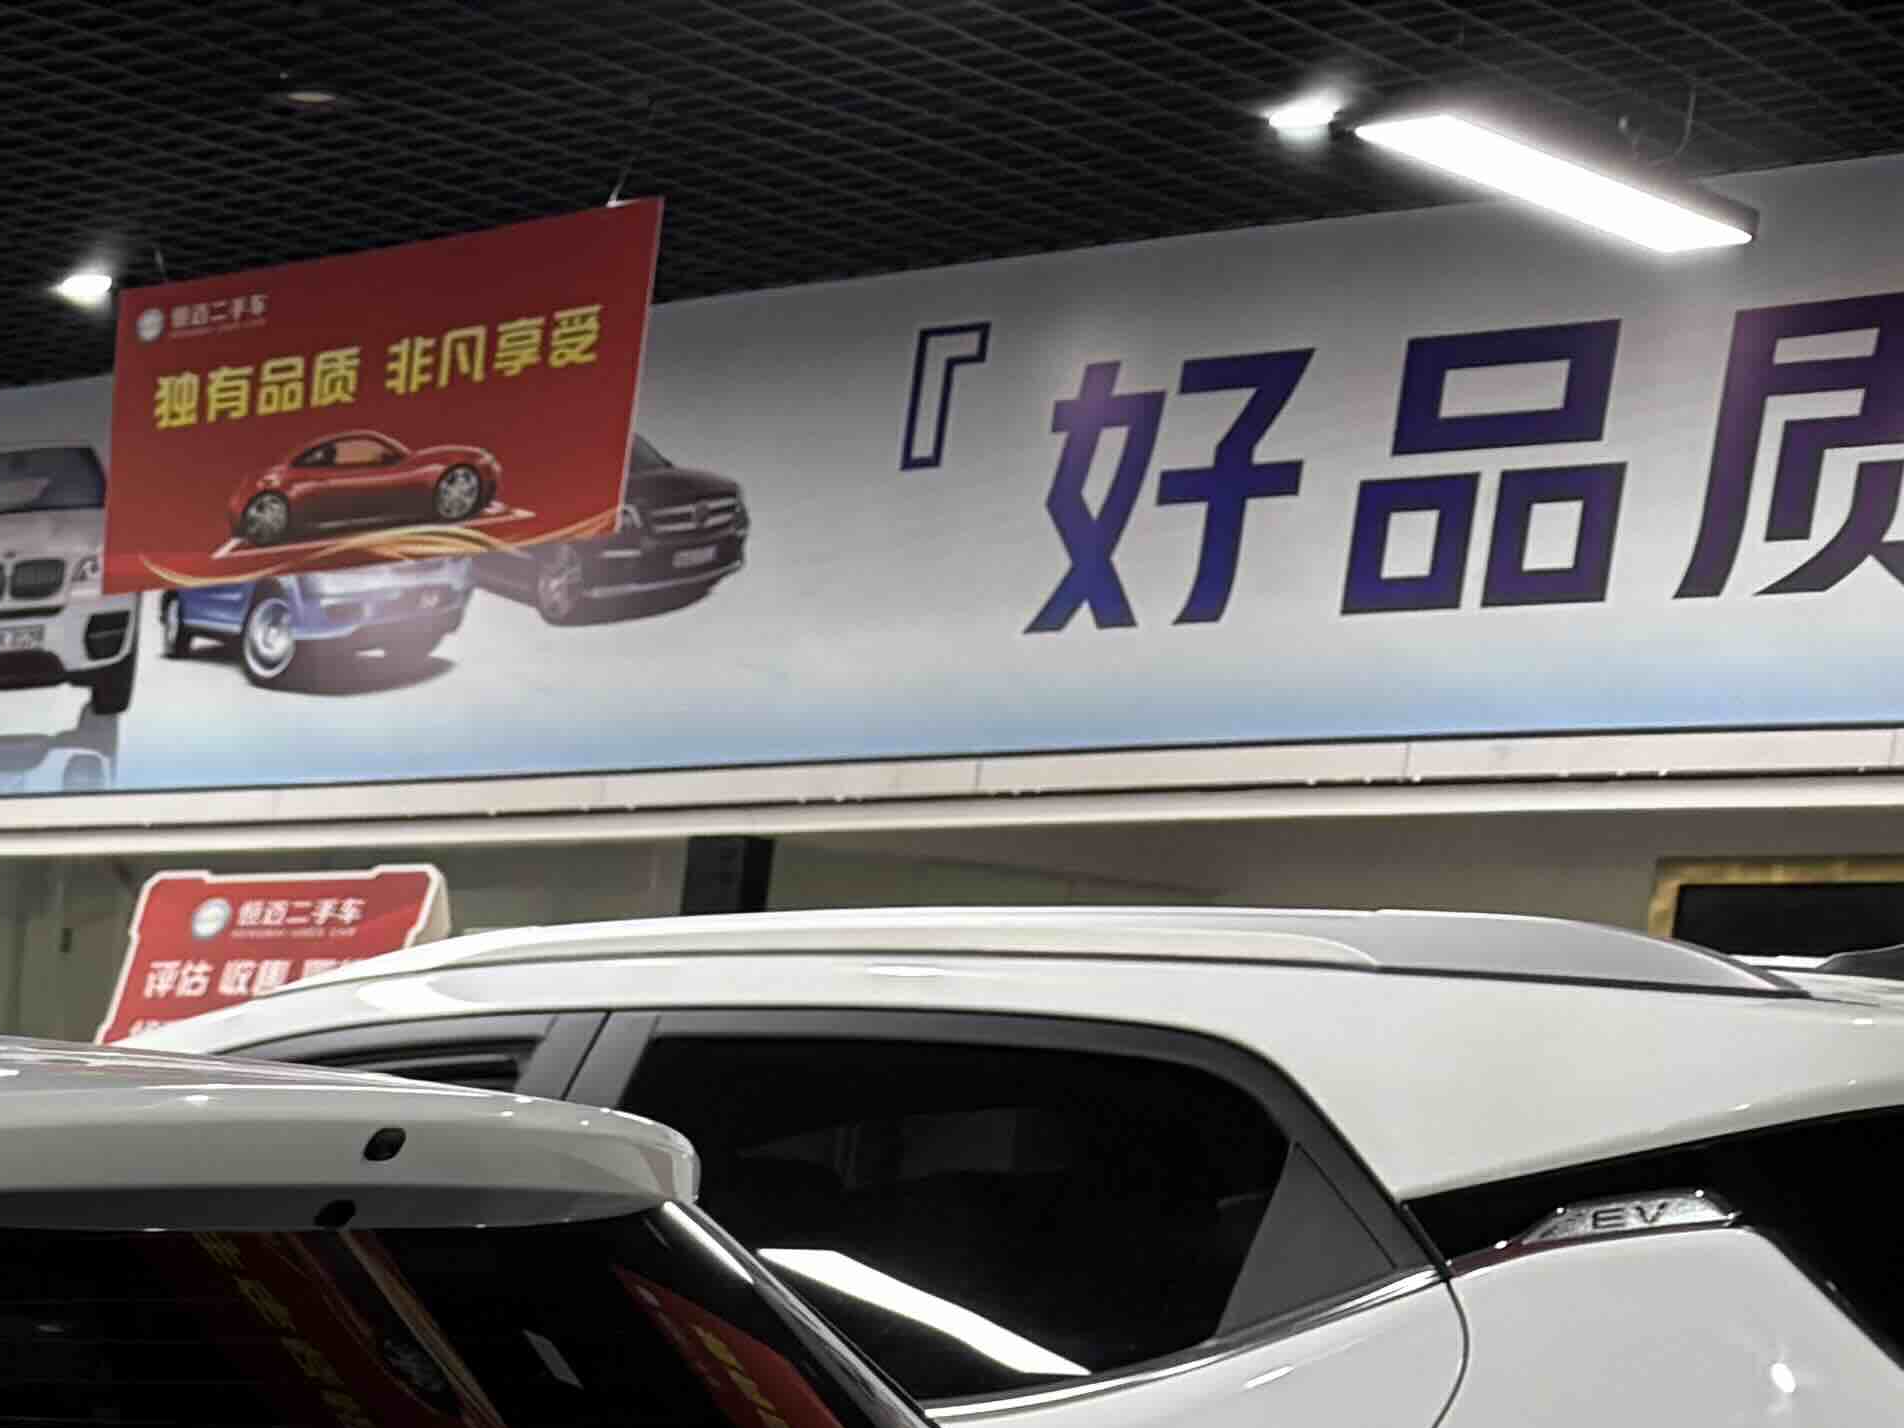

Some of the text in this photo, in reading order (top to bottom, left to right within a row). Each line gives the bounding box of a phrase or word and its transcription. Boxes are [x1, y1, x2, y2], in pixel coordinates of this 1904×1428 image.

[153, 303, 603, 429] 独有品质 非凡享受
[142, 960, 212, 999] 评估
[1592, 1202, 1669, 1230] EV
